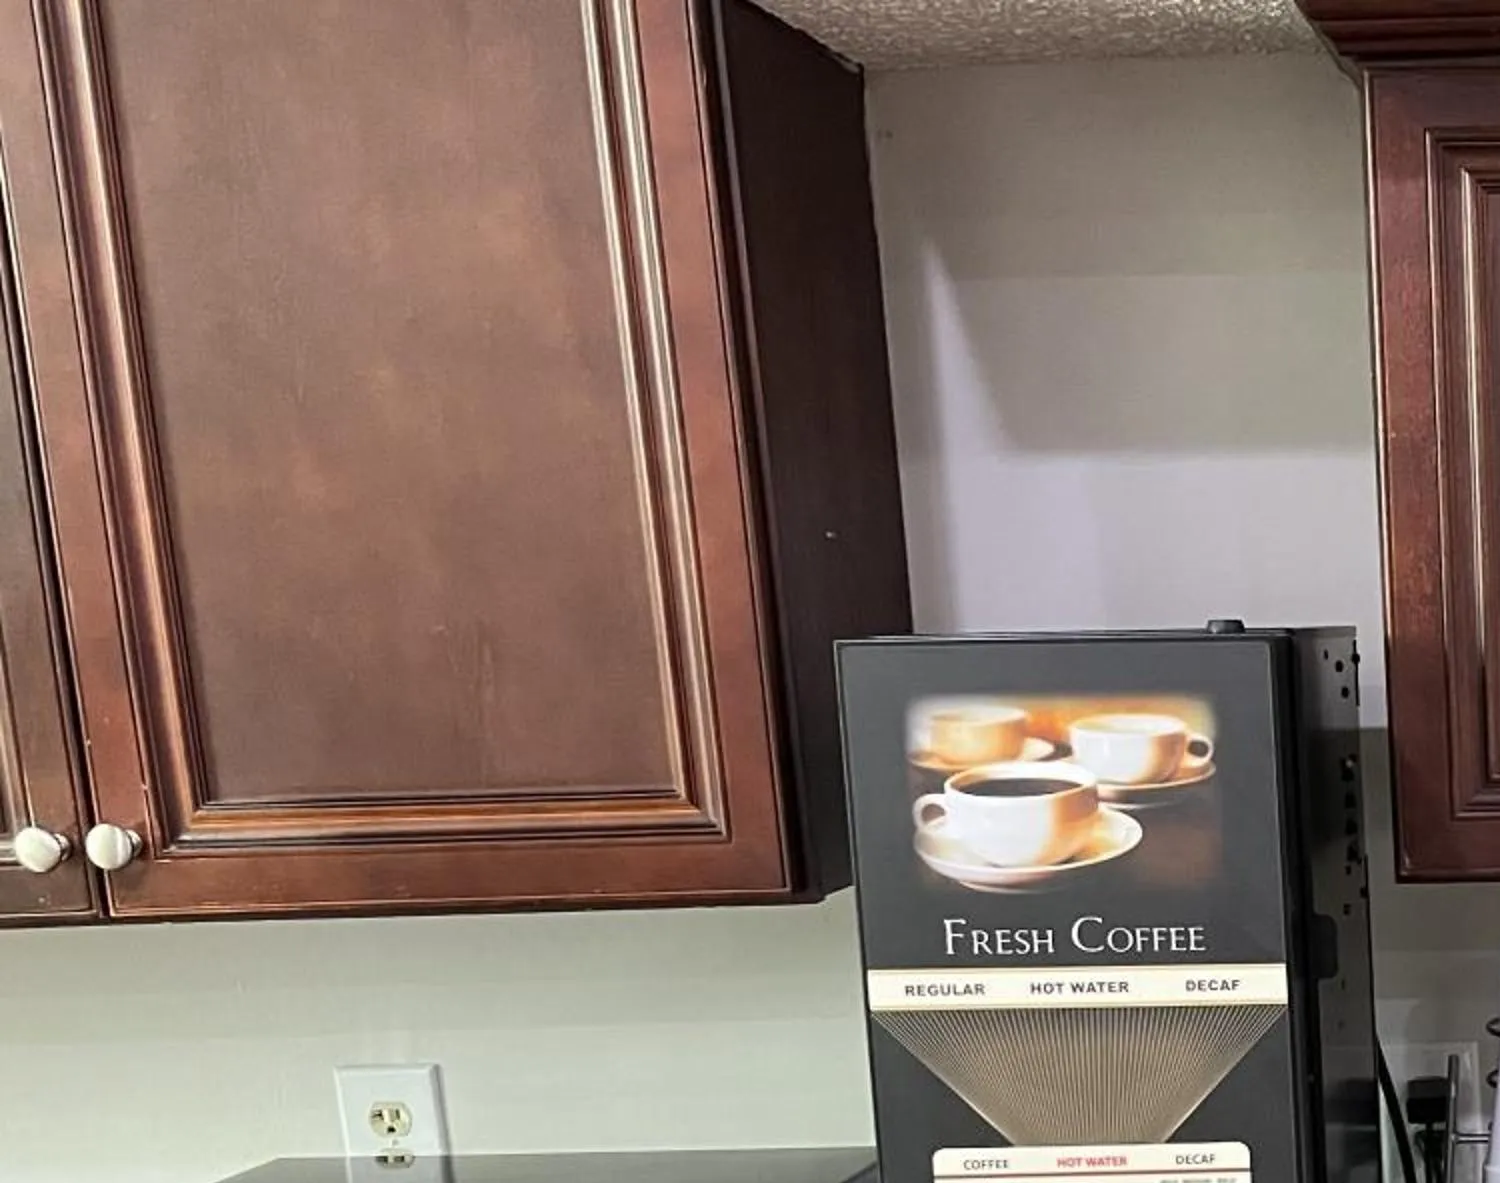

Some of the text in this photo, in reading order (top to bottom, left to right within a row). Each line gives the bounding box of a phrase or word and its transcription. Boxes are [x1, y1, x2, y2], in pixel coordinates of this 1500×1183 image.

[904, 983, 986, 997] REGULAR
[1030, 981, 1129, 995] HOT WATER
[1185, 979, 1241, 992] DECAF
[963, 1159, 1009, 1170] COFFEE
[1057, 1156, 1128, 1168] HOT WATER
[1175, 1153, 1217, 1165] DECAF
